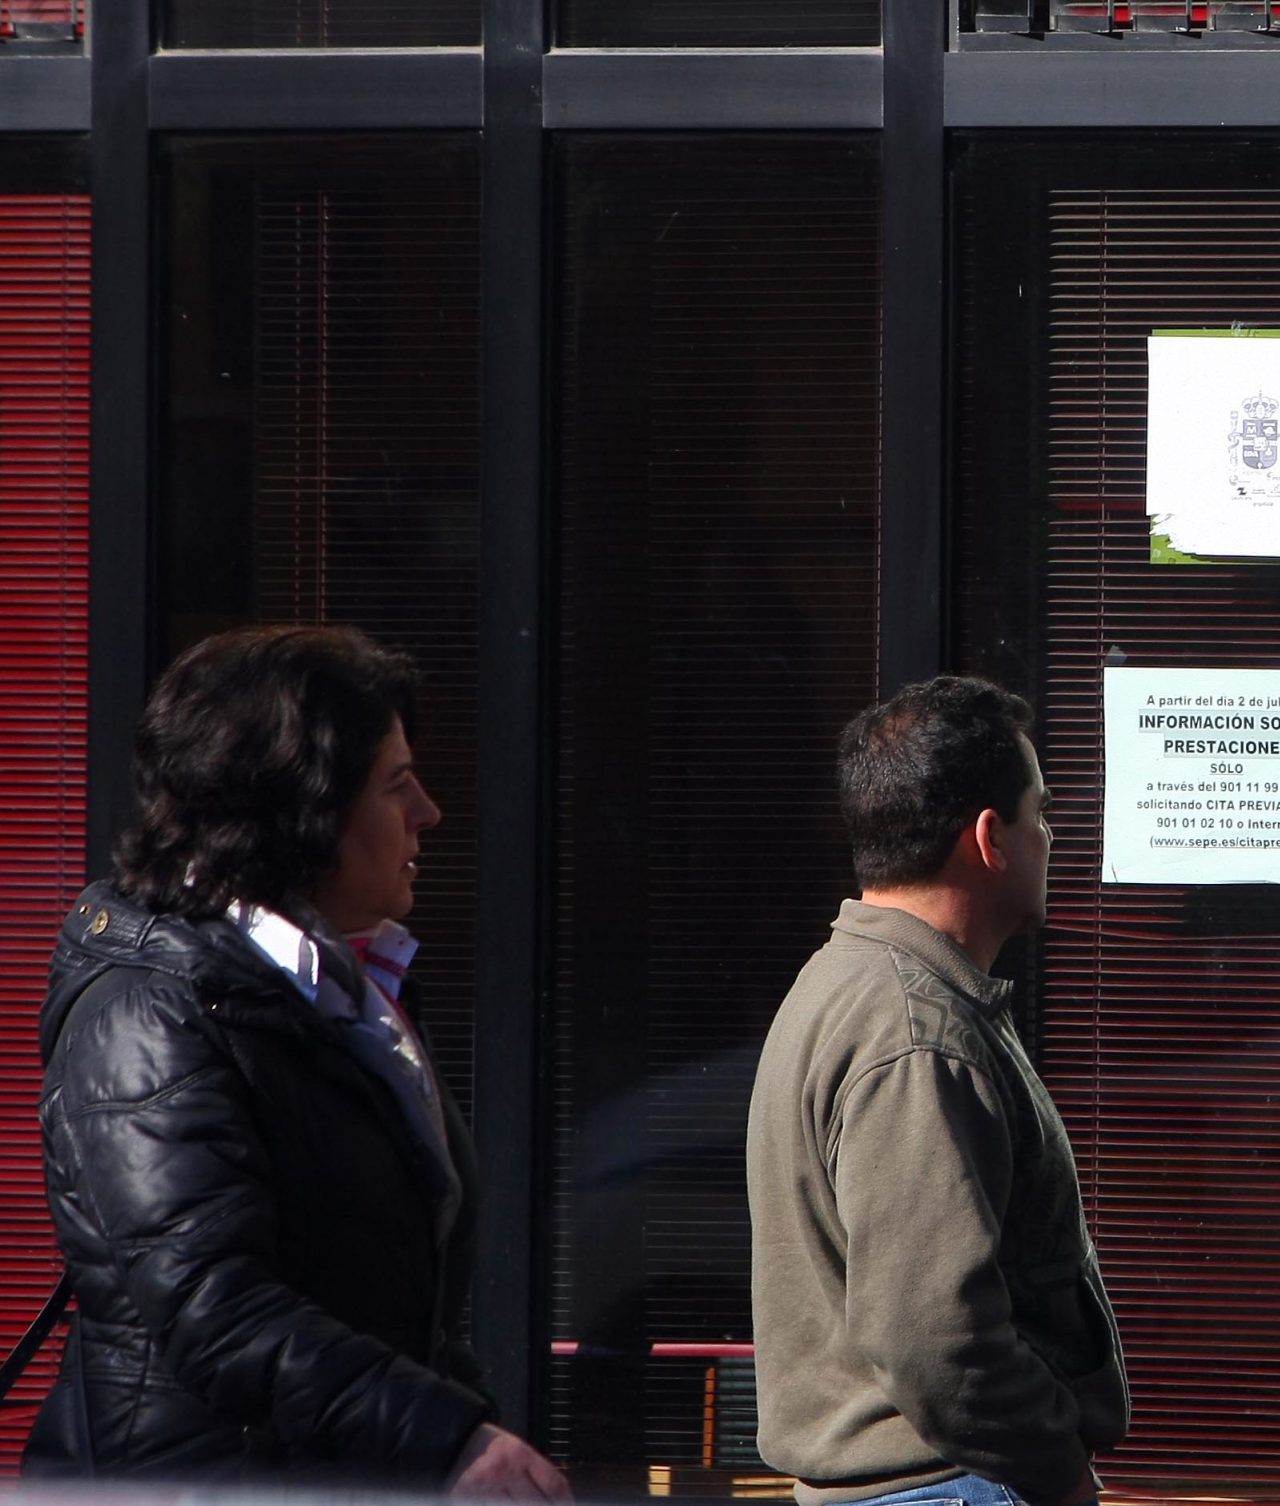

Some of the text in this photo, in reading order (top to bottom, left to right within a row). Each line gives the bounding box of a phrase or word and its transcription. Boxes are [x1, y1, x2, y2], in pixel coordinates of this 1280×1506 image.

[1146, 695, 1155, 705] A
[1159, 695, 1192, 708] partir
[1195, 695, 1213, 706] del
[1238, 696, 1245, 707] 2
[1249, 696, 1263, 707] de
[1139, 713, 1254, 730] INFORMACIÓN
[1210, 761, 1243, 774] SÓLO
[1146, 783, 1153, 791] a
[1157, 781, 1194, 792] través
[1198, 781, 1216, 792] del
[1220, 781, 1241, 792] 901
[1246, 782, 1259, 793] 11
[1264, 782, 1279, 793] 99
[1137, 799, 1202, 810] solicitando
[1206, 799, 1235, 810] CITA
[1157, 817, 1177, 828] 901
[1182, 817, 1195, 828] 01
[1200, 817, 1214, 828] 02
[1219, 818, 1233, 829] 10
[1237, 821, 1244, 829] o
